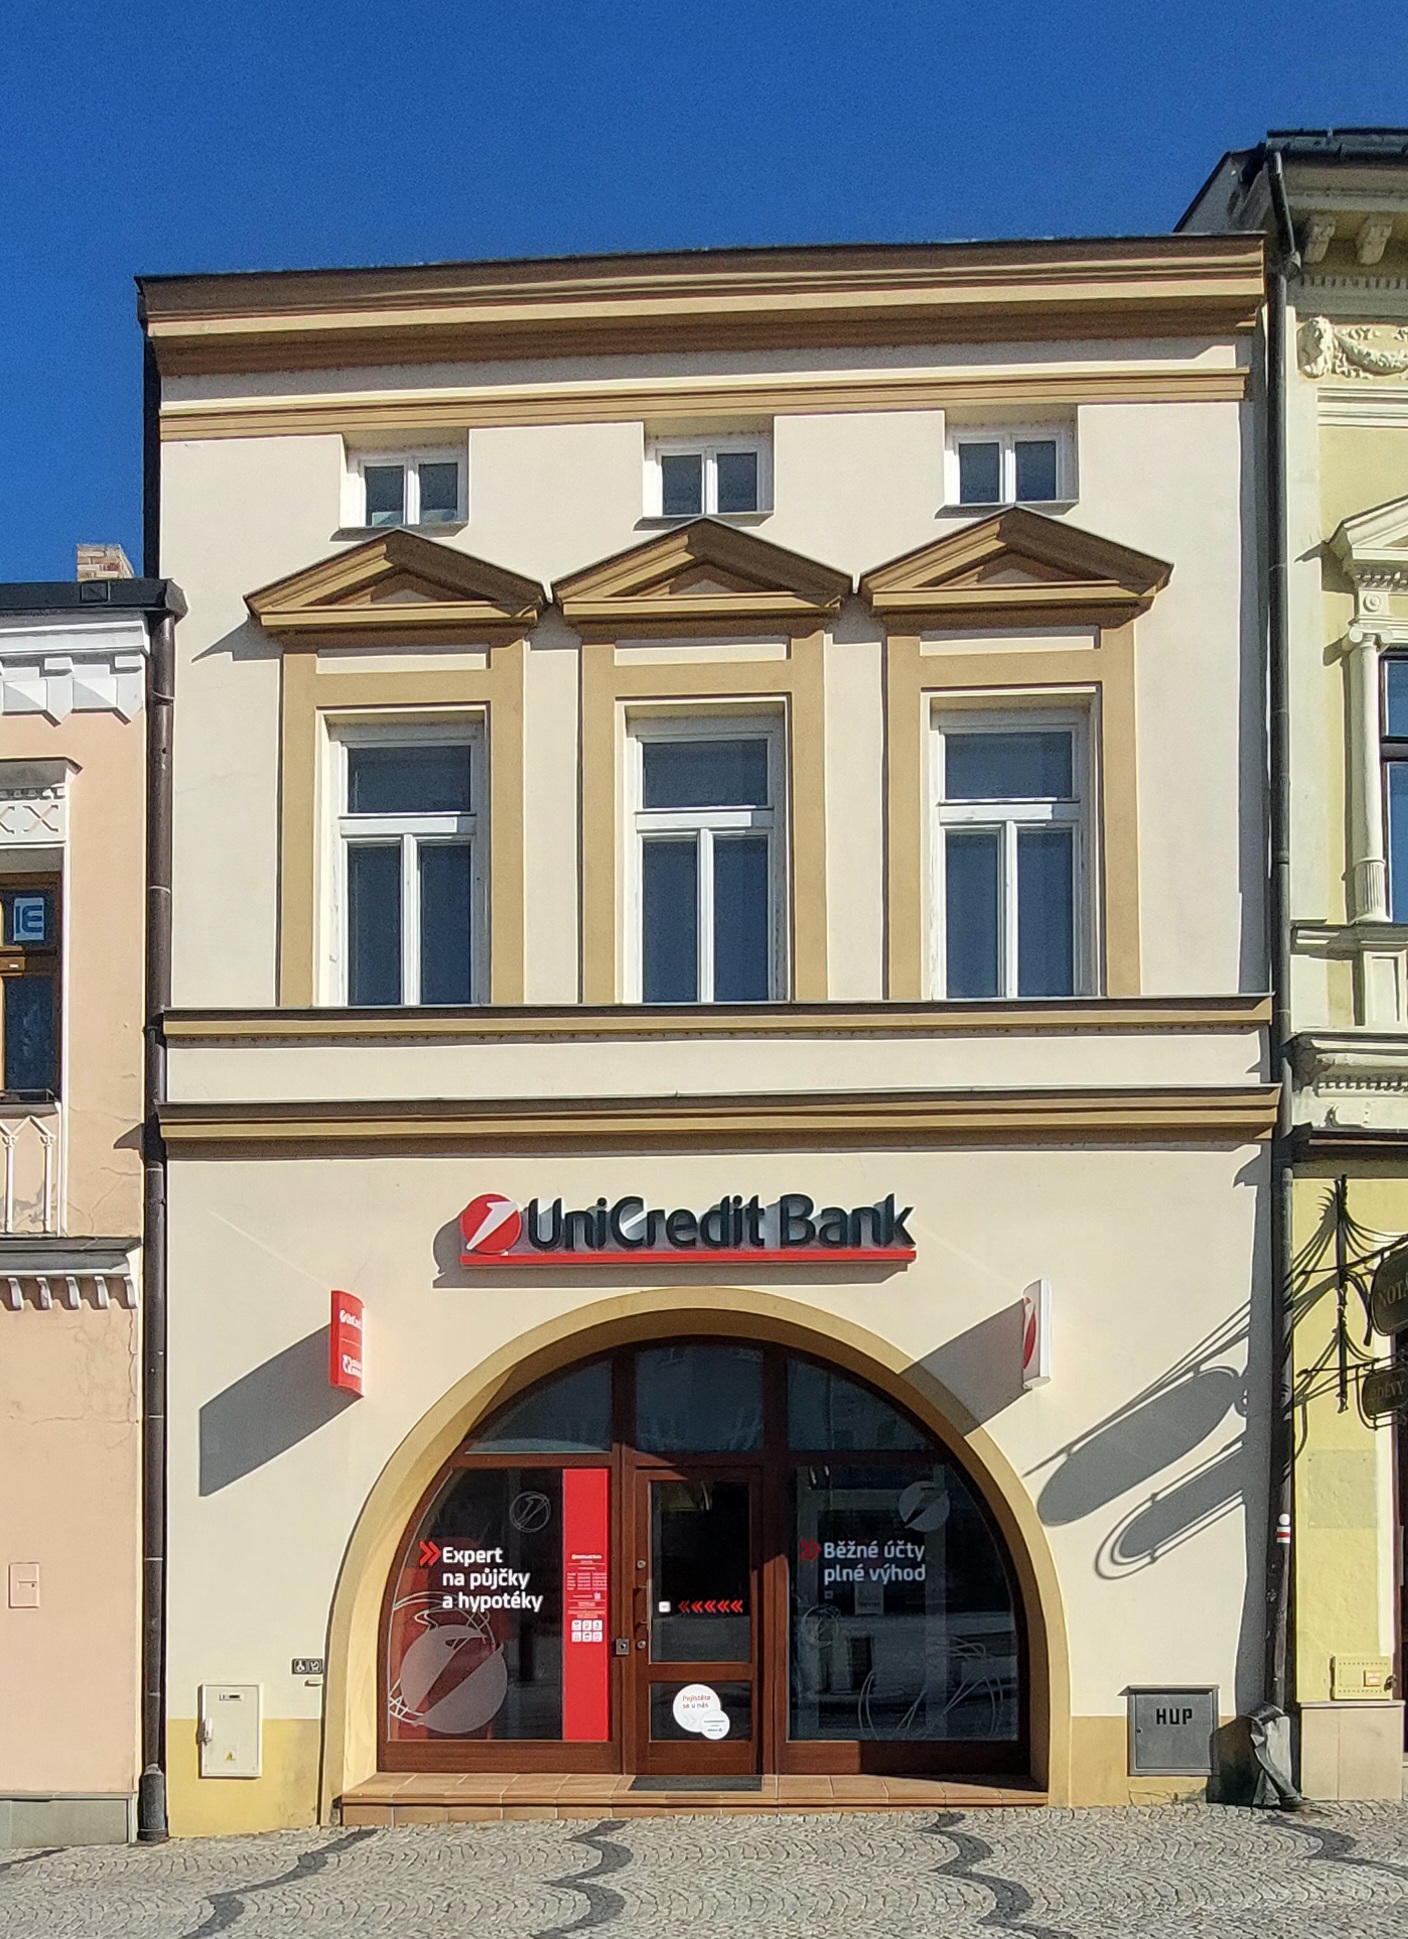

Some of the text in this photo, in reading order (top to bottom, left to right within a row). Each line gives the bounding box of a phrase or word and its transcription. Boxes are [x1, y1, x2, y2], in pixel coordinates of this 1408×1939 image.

[528, 1191, 917, 1249] UniCredit Bank
[442, 1546, 504, 1566] Expert
[823, 1540, 926, 1562] Běžné účty
[442, 1568, 531, 1591] na půjčky
[823, 1563, 926, 1586] plné výhod
[442, 1590, 544, 1613] a hypotéky
[1156, 1708, 1193, 1725] HUP
